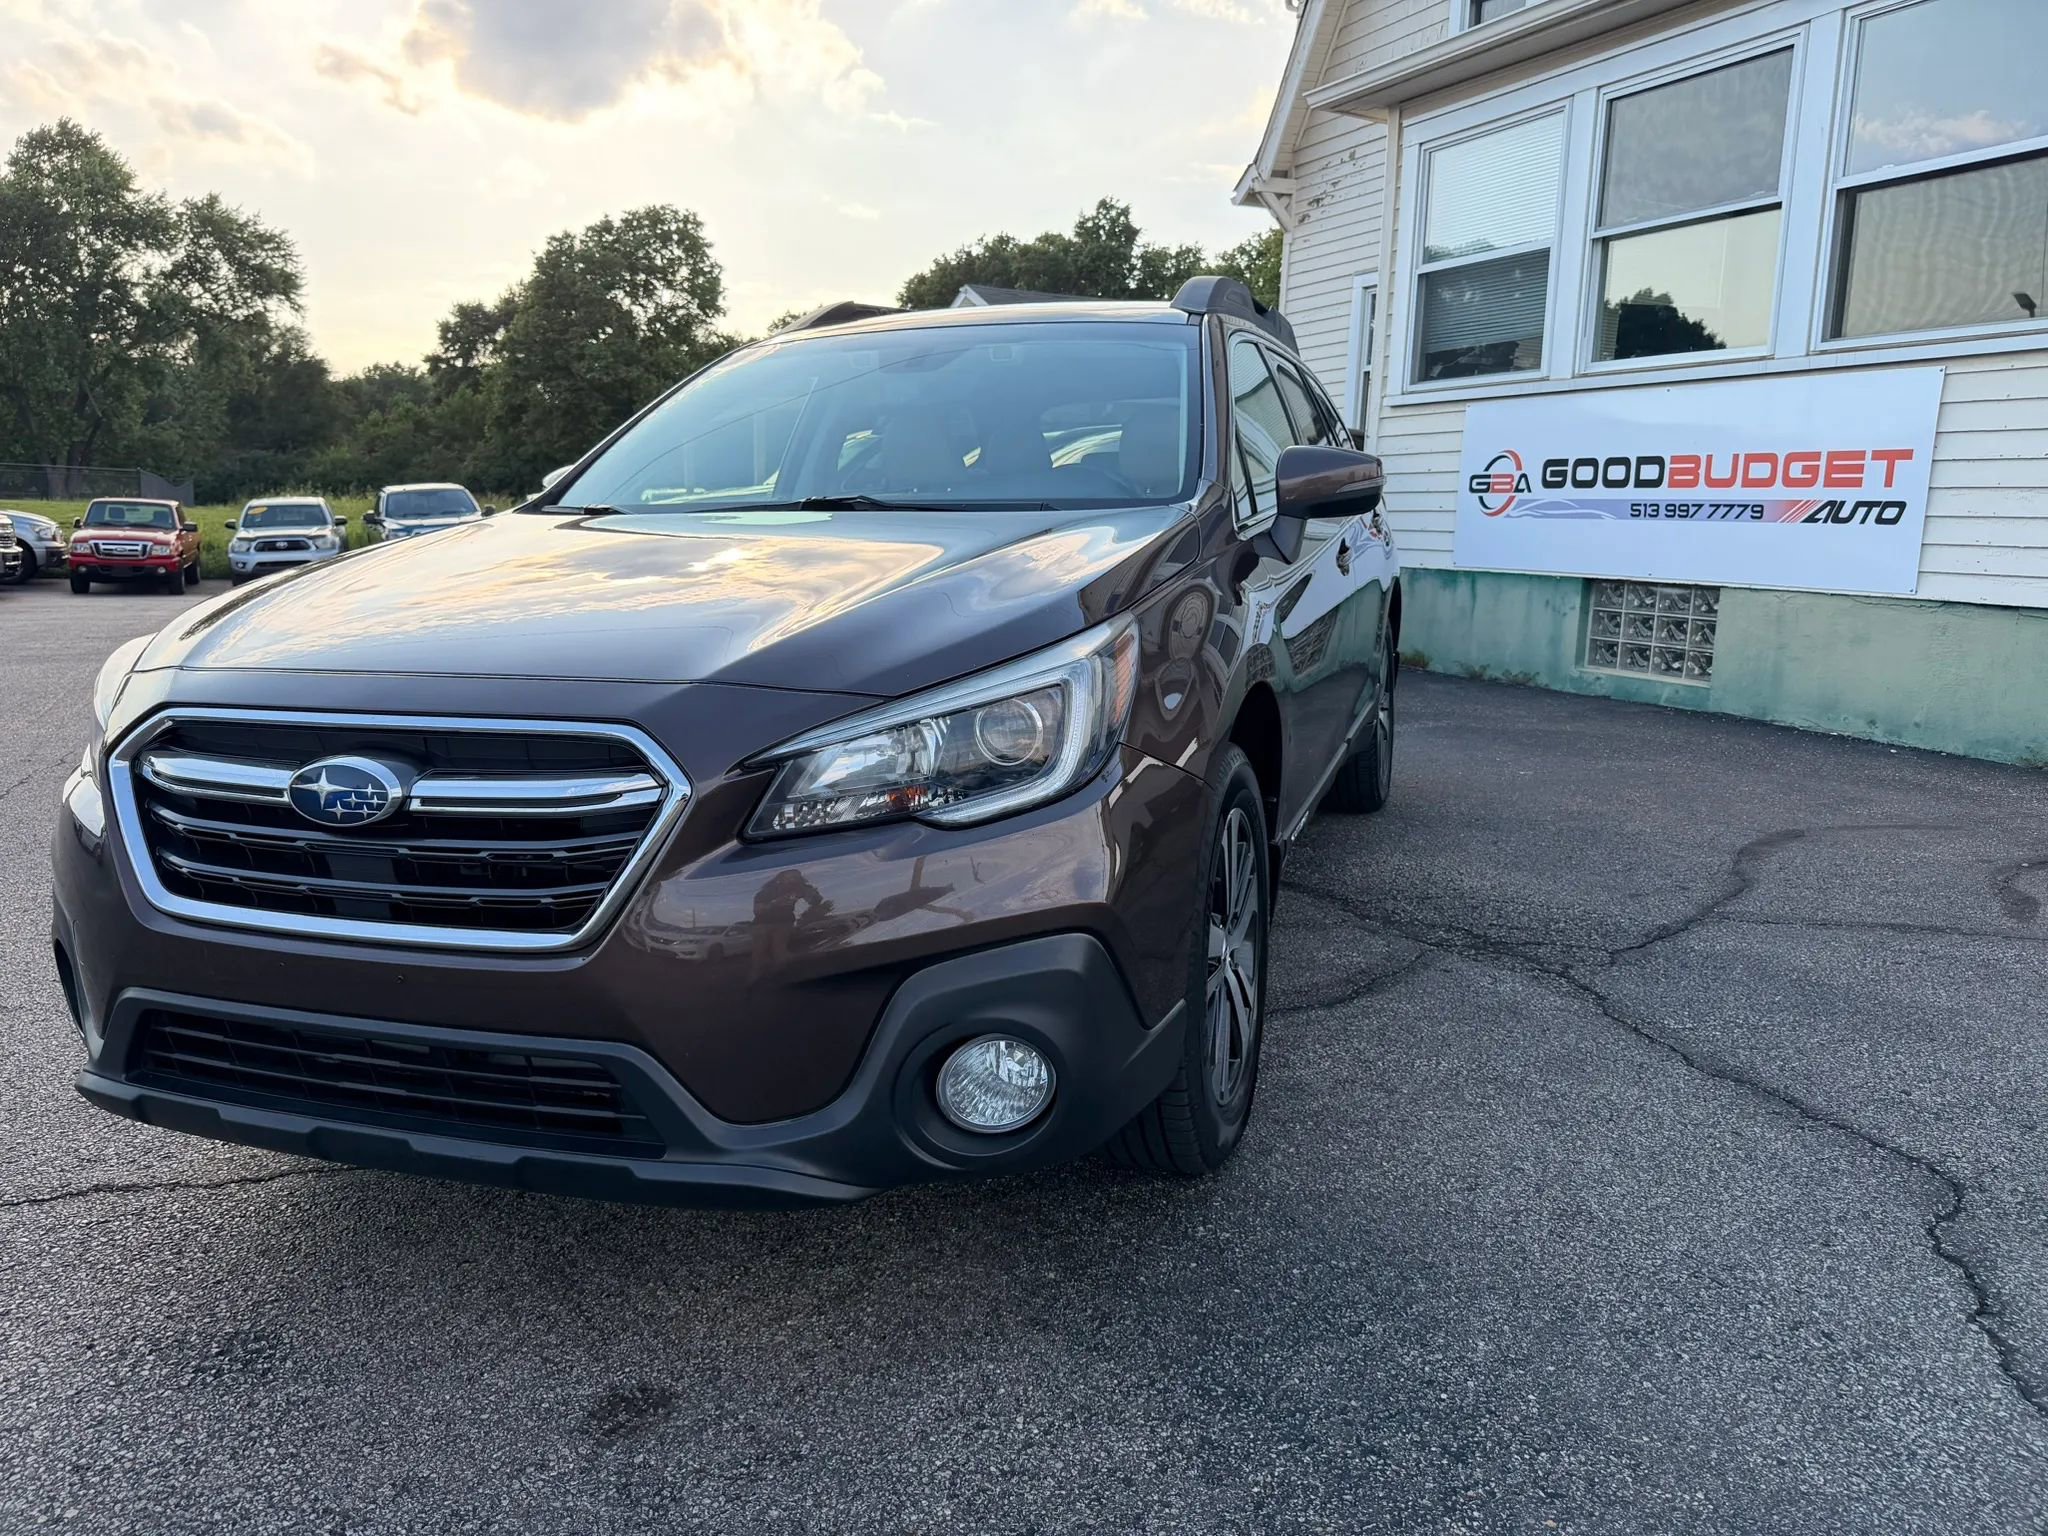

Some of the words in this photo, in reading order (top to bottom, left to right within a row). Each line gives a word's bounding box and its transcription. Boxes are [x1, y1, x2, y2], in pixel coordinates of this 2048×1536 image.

[1469, 473, 1532, 493] GBA
[1630, 503, 1660, 518] 513
[1664, 503, 1704, 519] 997
[1707, 503, 1764, 520] 7779
[1800, 500, 1907, 525] AUTO
